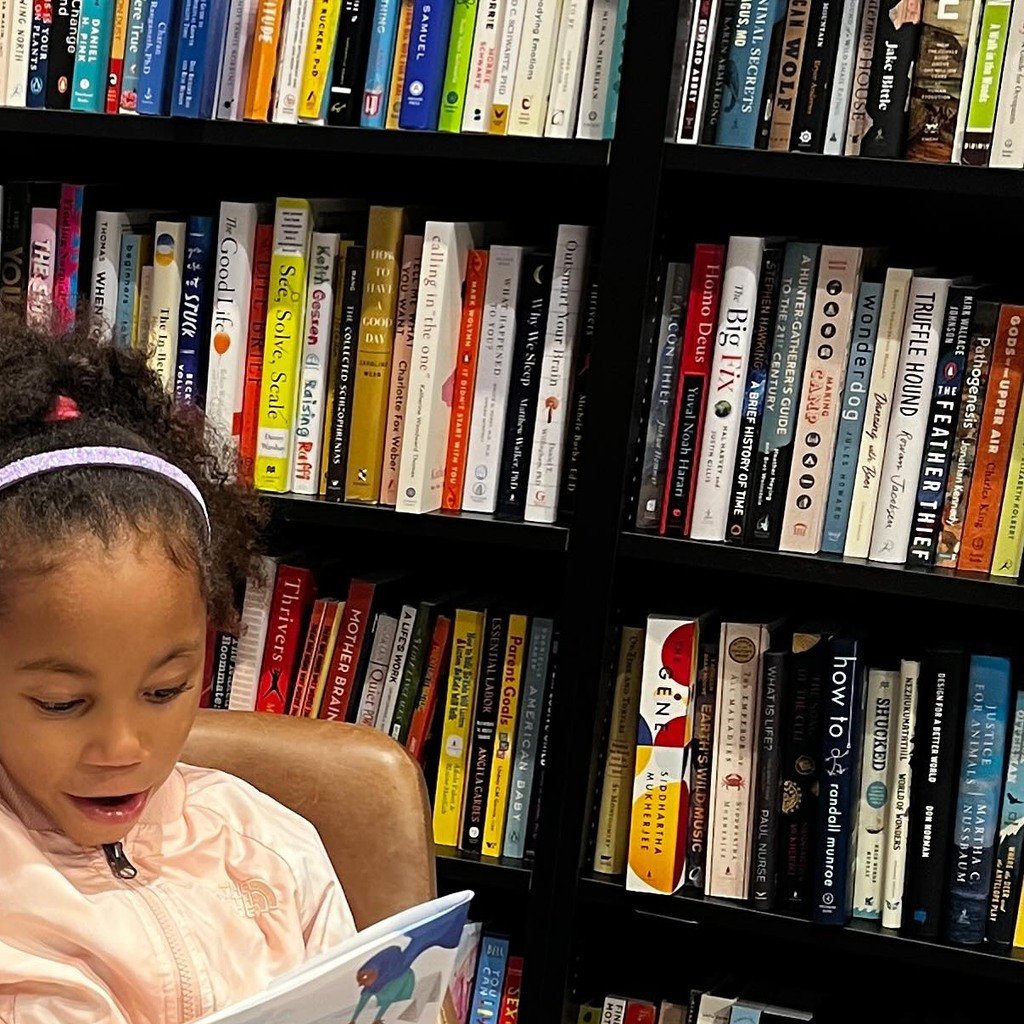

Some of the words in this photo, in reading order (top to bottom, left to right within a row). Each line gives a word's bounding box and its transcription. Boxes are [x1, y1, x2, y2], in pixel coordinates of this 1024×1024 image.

[30, 25, 41, 71] PLANTS
[78, 33, 88, 62] PINK
[88, 19, 100, 63] DANIEL
[416, 4, 431, 61] SAMUEL
[693, 19, 708, 66] EDWARD
[777, 37, 802, 112] WOLF
[884, 40, 899, 71] Jake
[688, 66, 701, 104] ABBEY
[741, 47, 763, 114] SECRETS
[879, 73, 895, 111] Bittle
[216, 237, 238, 296] Good
[274, 264, 297, 305] See,
[559, 240, 578, 307] Outsmart
[527, 298, 543, 325] Why
[700, 263, 720, 319] Homo
[181, 292, 200, 338] STUCK
[214, 299, 235, 332] Life
[554, 312, 569, 345] Your
[718, 307, 748, 348] Big
[782, 269, 810, 392] HUNTER-GATHERER'S
[908, 292, 936, 358] TRUFFLE
[270, 310, 292, 366] Solve,
[526, 331, 539, 351] We
[695, 322, 713, 365] Deus
[395, 360, 407, 412] Charlotte
[520, 353, 535, 386] Sleep
[549, 350, 564, 386] Brain
[716, 354, 743, 393] Fix
[750, 380, 759, 391] A
[963, 337, 991, 430] Pathogenesis
[266, 371, 286, 420] Scale
[296, 378, 318, 438] Raising
[685, 385, 700, 417] Yuval
[746, 392, 760, 424] BRIEF
[900, 362, 924, 418] HOUND
[938, 386, 958, 396] THE
[992, 379, 1011, 425] UPPER
[777, 392, 792, 435] GUIDE
[389, 436, 401, 471] Weber
[679, 420, 696, 454] Noah
[739, 426, 755, 472] HISTORY
[924, 399, 955, 492] FEATHER
[987, 430, 1002, 454] AIR
[294, 441, 314, 482] Raffi
[674, 456, 690, 499] Harari
[738, 472, 748, 488] OF
[733, 489, 746, 515] TIME
[911, 500, 938, 561] THIEF
[272, 577, 302, 663] Thrivers
[338, 608, 362, 674] MOTHER
[504, 635, 523, 683] Parent
[765, 665, 777, 702] WHAT
[830, 656, 858, 707] how
[498, 685, 516, 726] Goals
[764, 706, 775, 717] IS
[828, 715, 848, 739] to
[517, 684, 538, 771] AMERICAN
[763, 719, 773, 752] LIFE?
[872, 697, 891, 771] SHUCKED
[981, 704, 997, 767] JUSTICE
[512, 780, 526, 822] BABY
[640, 772, 655, 851] MUKHERJEE
[654, 771, 669, 855] SIDDHARTHA
[826, 783, 841, 832] randall
[759, 808, 771, 843] PAUL
[956, 804, 973, 883] NUSSBAUM
[756, 844, 769, 884] NURSE
[823, 837, 836, 887] munroe
